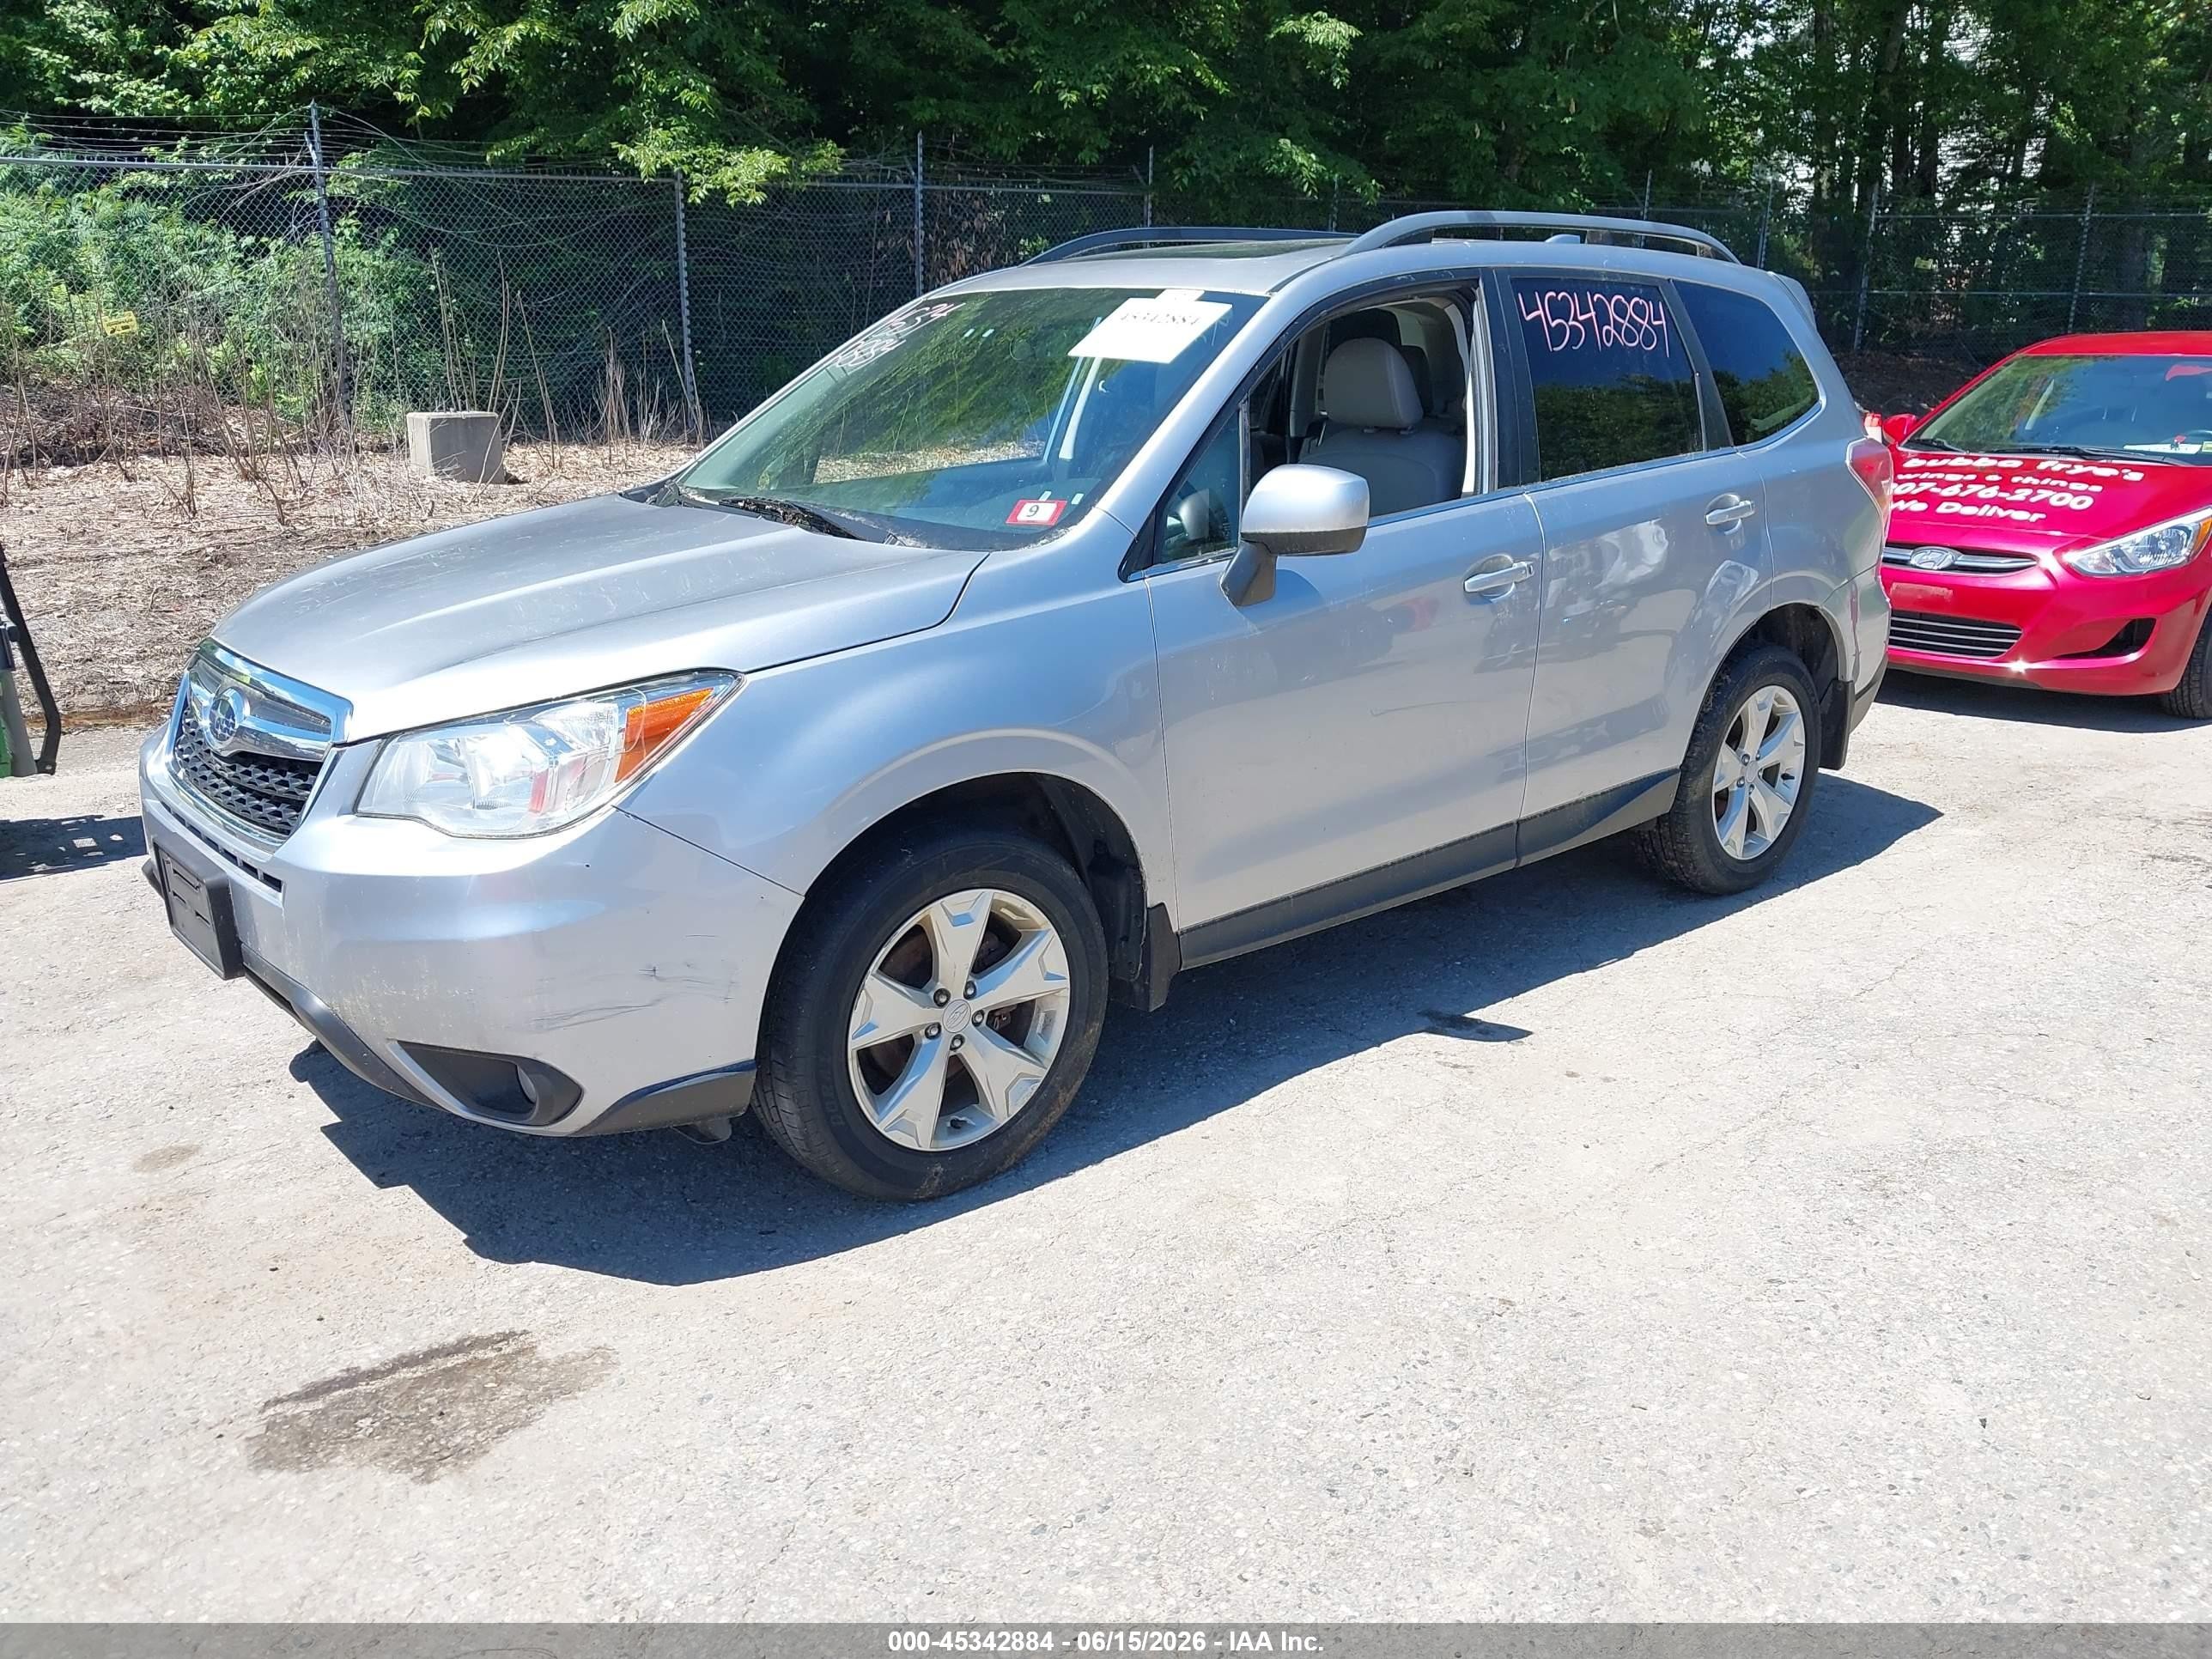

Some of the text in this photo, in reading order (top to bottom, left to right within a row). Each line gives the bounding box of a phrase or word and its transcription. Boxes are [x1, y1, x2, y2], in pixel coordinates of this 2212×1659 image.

[1517, 291, 1670, 358] 45342884
[1896, 472, 1977, 481] wings
[2010, 476, 2103, 492] things
[1026, 504, 1040, 517] 9
[1935, 501, 2047, 523] Deliver
